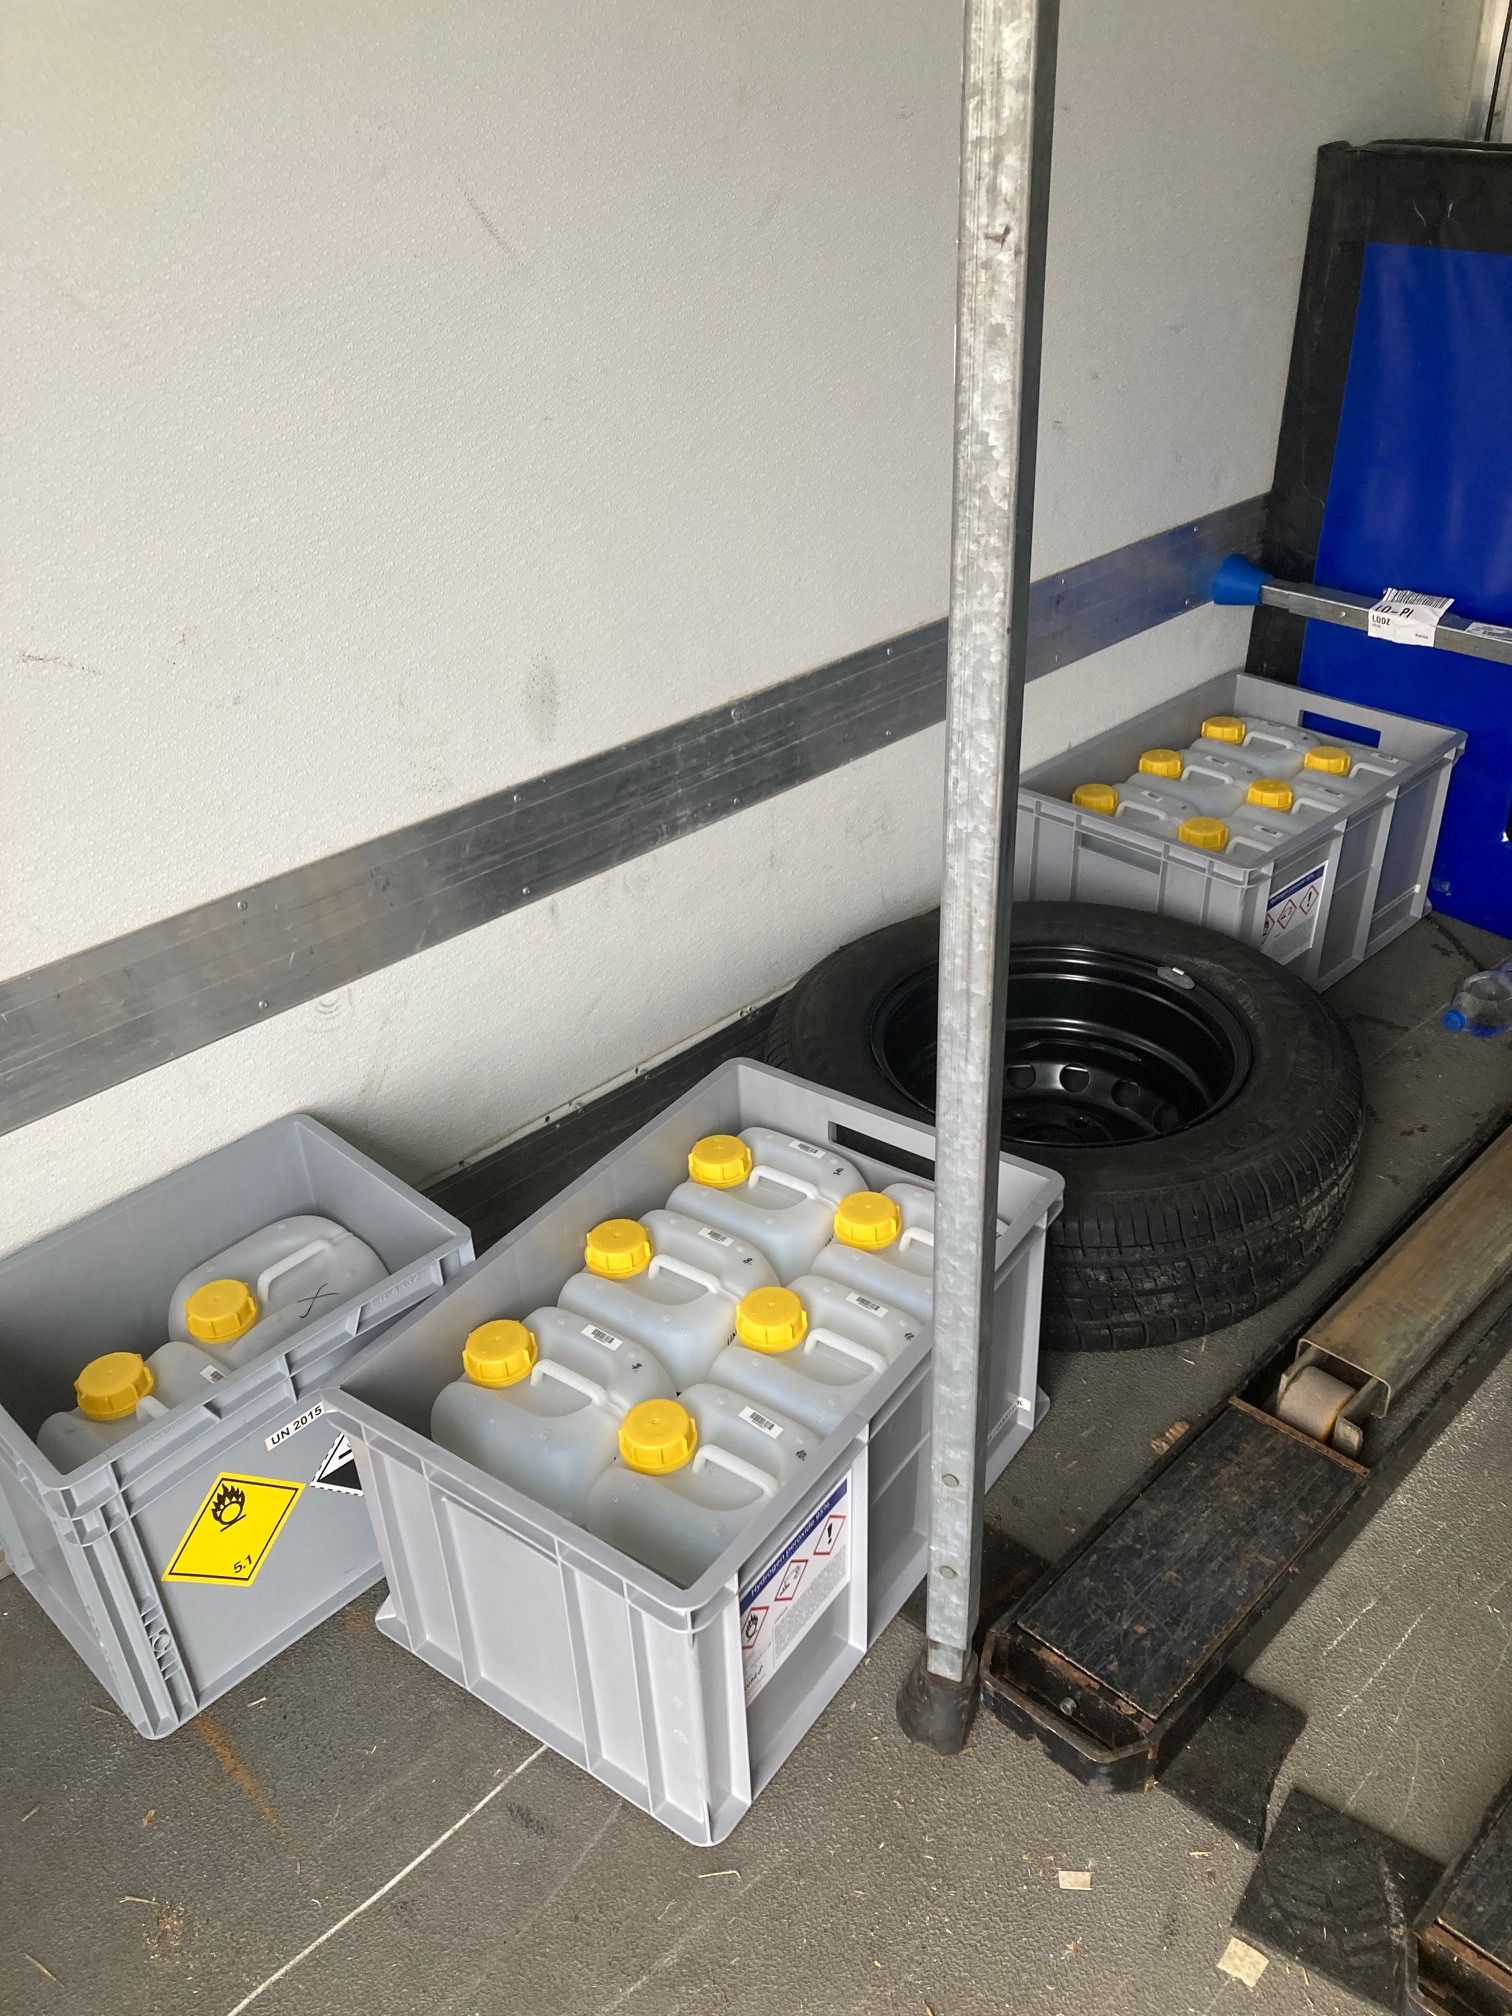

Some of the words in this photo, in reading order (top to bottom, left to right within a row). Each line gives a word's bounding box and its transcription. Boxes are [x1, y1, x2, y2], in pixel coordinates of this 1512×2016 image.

[1372, 615, 1391, 626] LODZ
[271, 1427, 291, 1446] UN
[293, 1406, 323, 1430] 2015
[233, 1555, 254, 1574] 5.1
[751, 1554, 785, 1598] Hydrogen
[785, 1518, 815, 1558] peroxide
